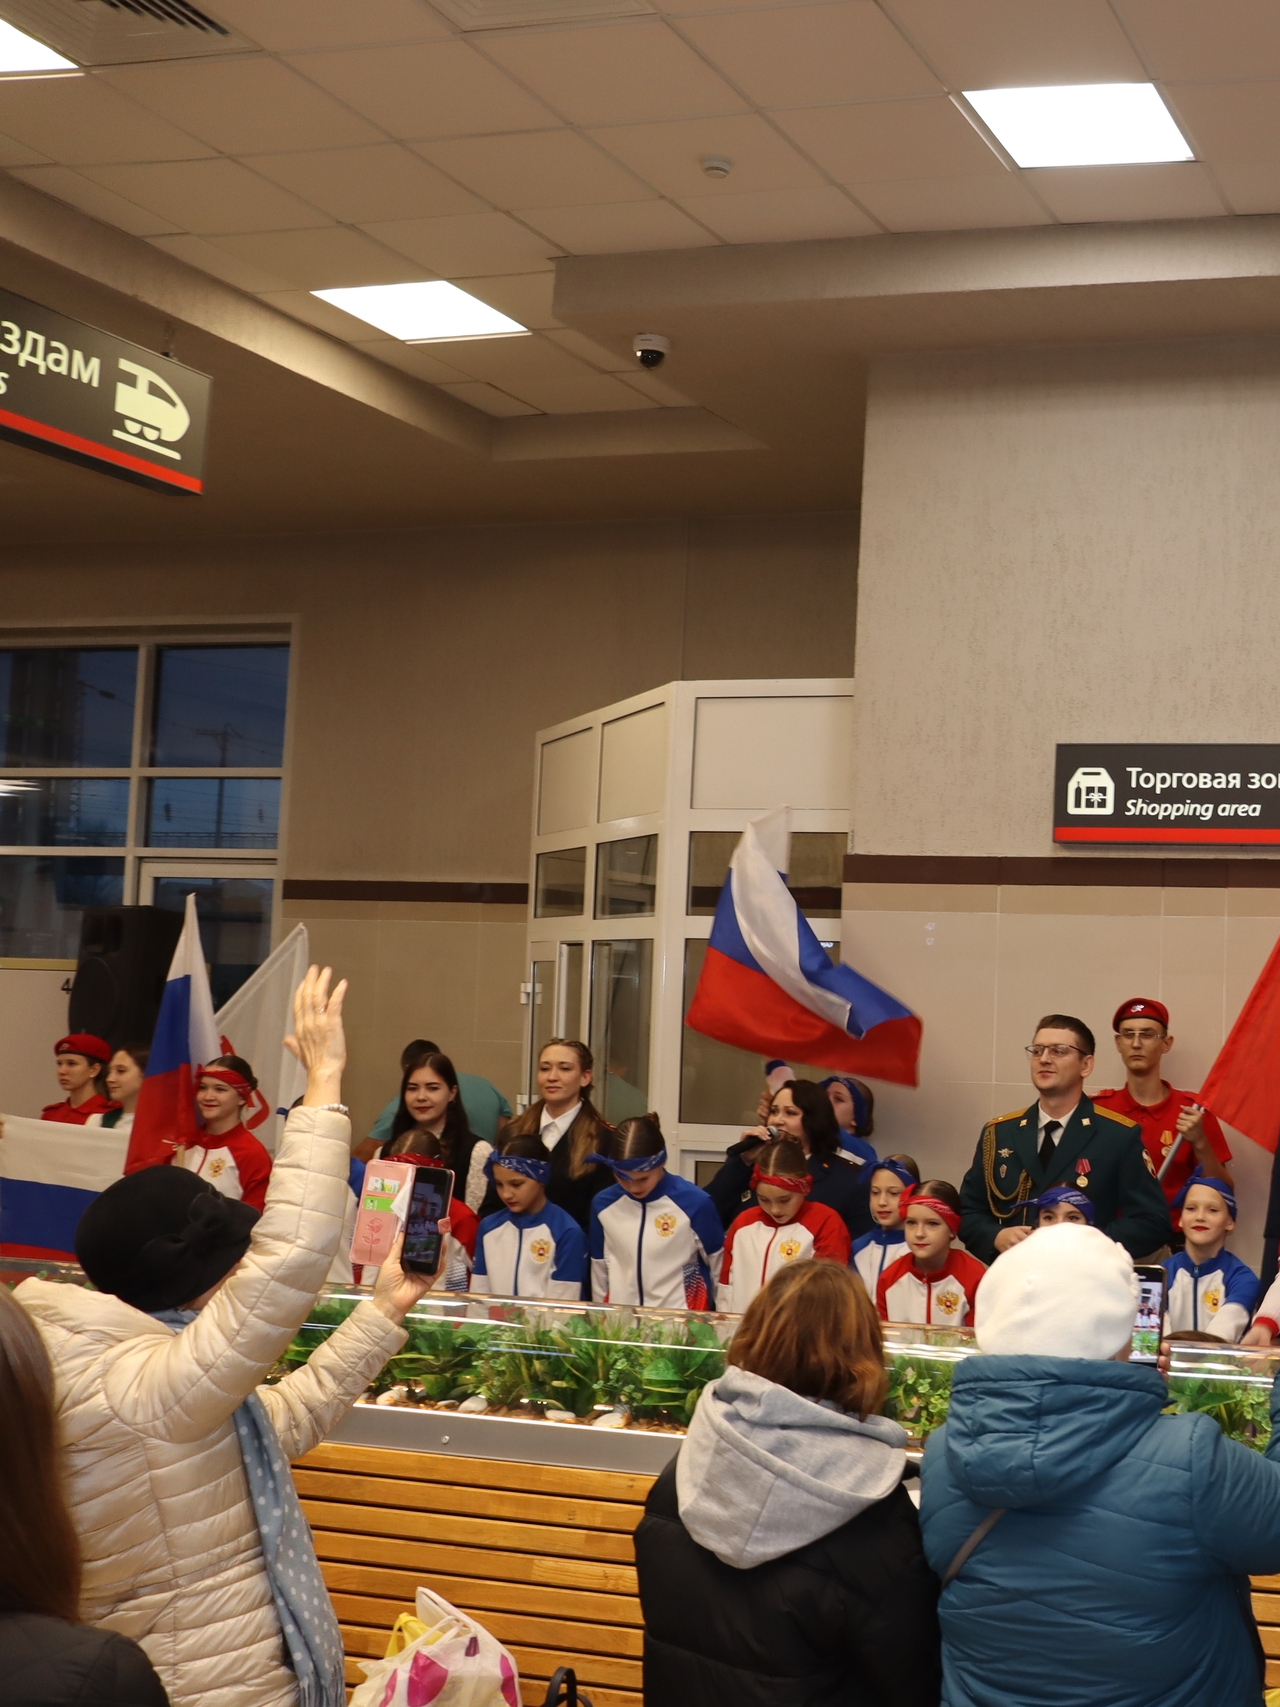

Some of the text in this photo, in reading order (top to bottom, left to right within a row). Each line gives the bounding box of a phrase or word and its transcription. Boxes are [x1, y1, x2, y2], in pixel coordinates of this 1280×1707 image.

[1125, 766, 1242, 795] Торговая
[1124, 798, 1262, 821] Shopping area
